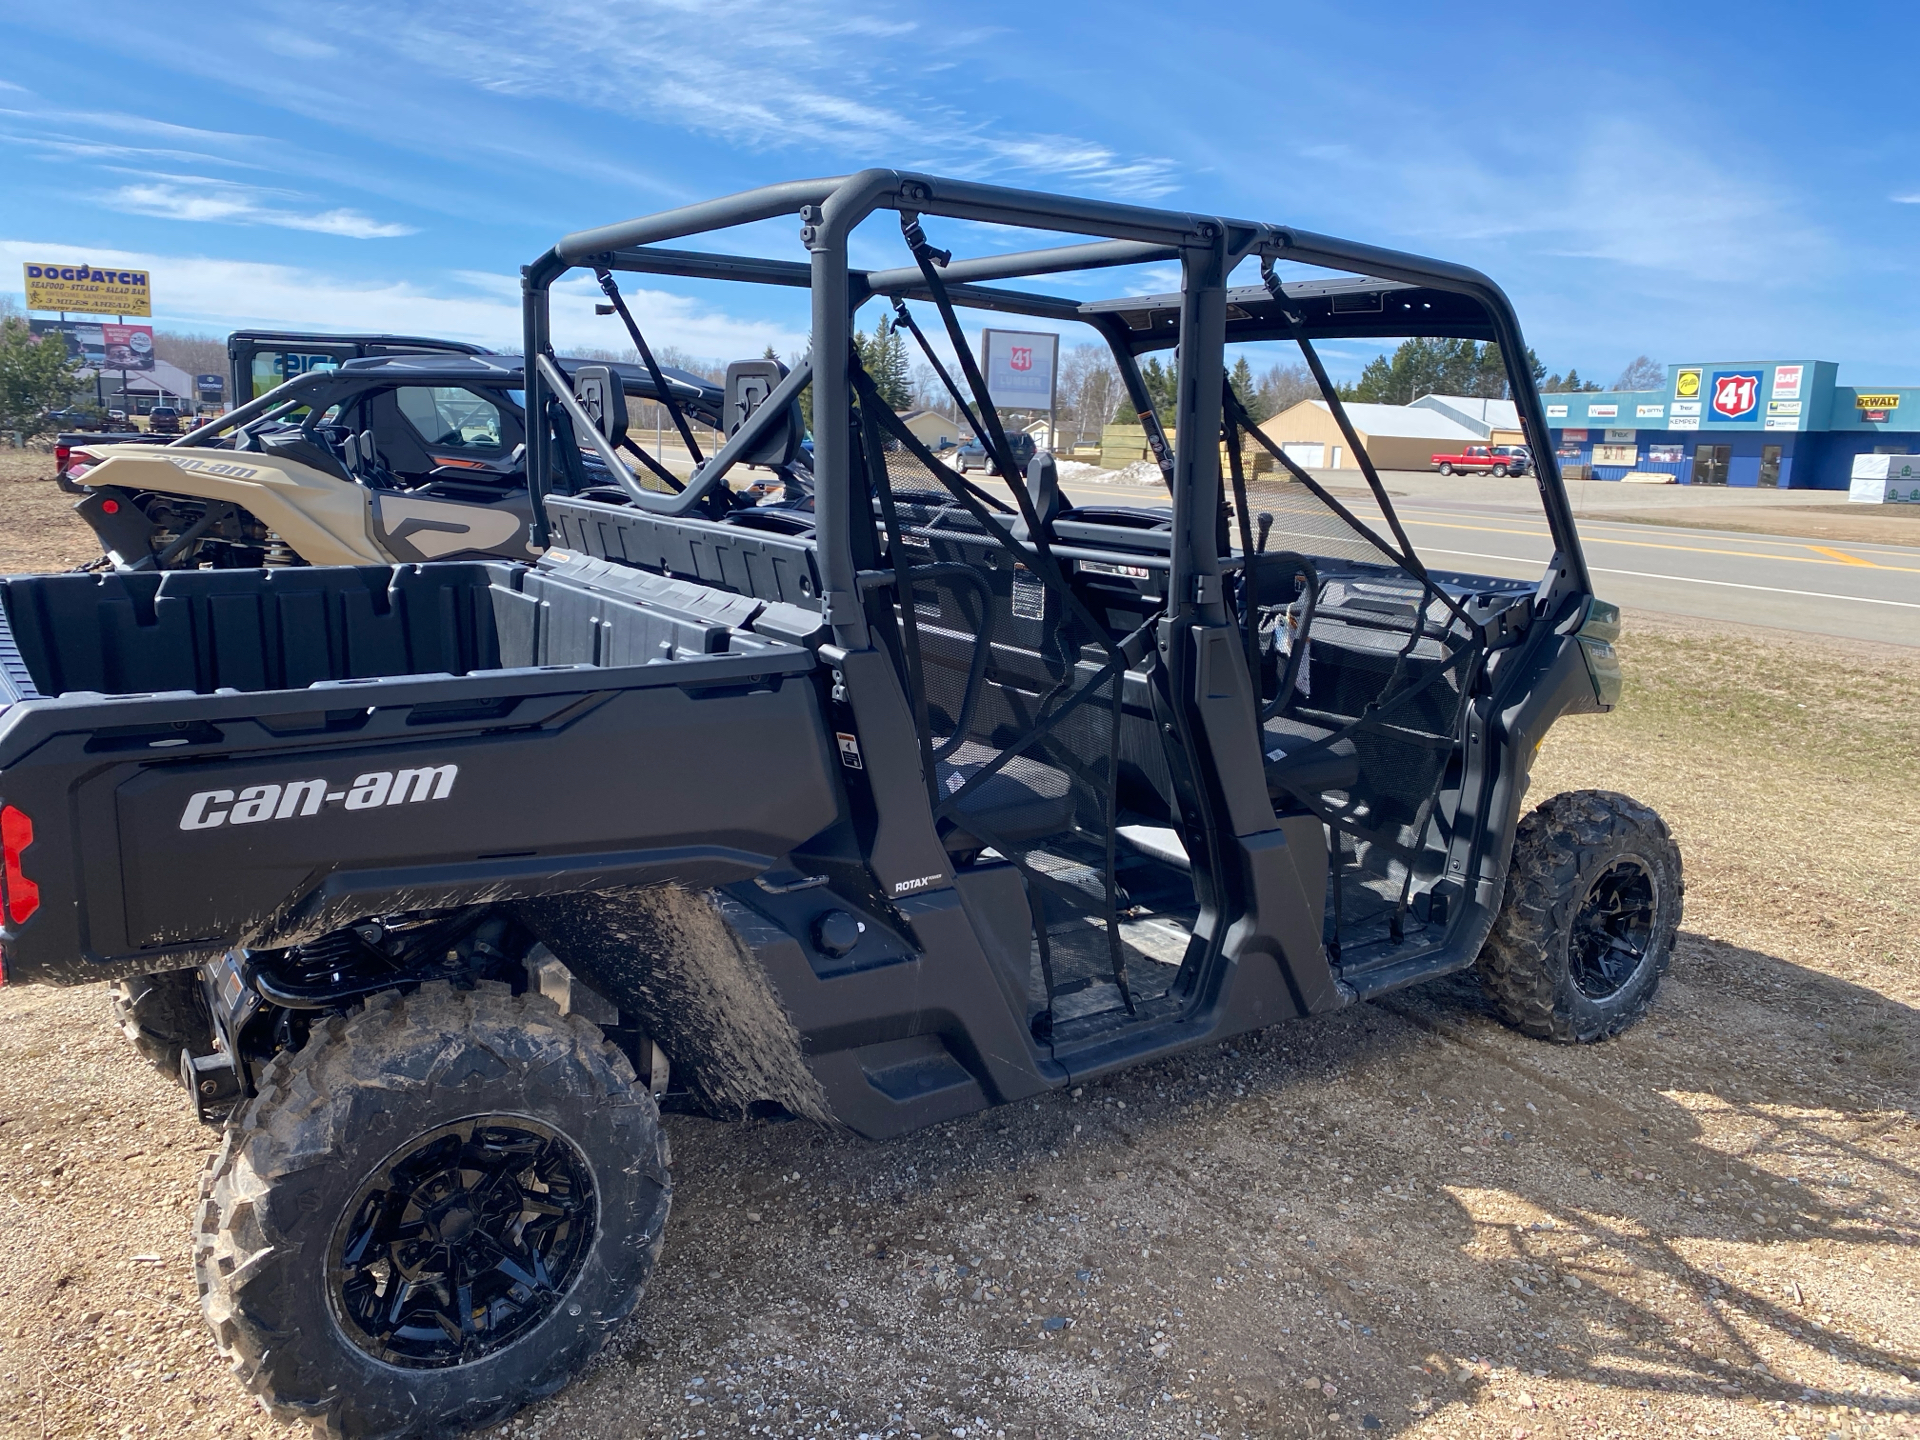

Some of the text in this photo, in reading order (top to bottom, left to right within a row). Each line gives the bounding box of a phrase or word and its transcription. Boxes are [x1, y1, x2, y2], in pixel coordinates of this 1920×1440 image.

[27, 266, 146, 286] DOGPATCH
[30, 281, 65, 291] SEAFOOD
[70, 283, 99, 292] STEAKS
[105, 286, 130, 295] SALAD
[131, 288, 146, 296] BAR
[45, 291, 129, 302] AWESOME SANDWICHES
[91, 301, 131, 309] AHEAD
[1012, 350, 1031, 368] 41
[1001, 375, 1042, 387] LUMBER
[1777, 374, 1798, 383] GAF
[1718, 382, 1752, 409] 41
[1611, 430, 1629, 438] Trex
[179, 764, 458, 831] can-am
[895, 876, 929, 893] ROTAX
